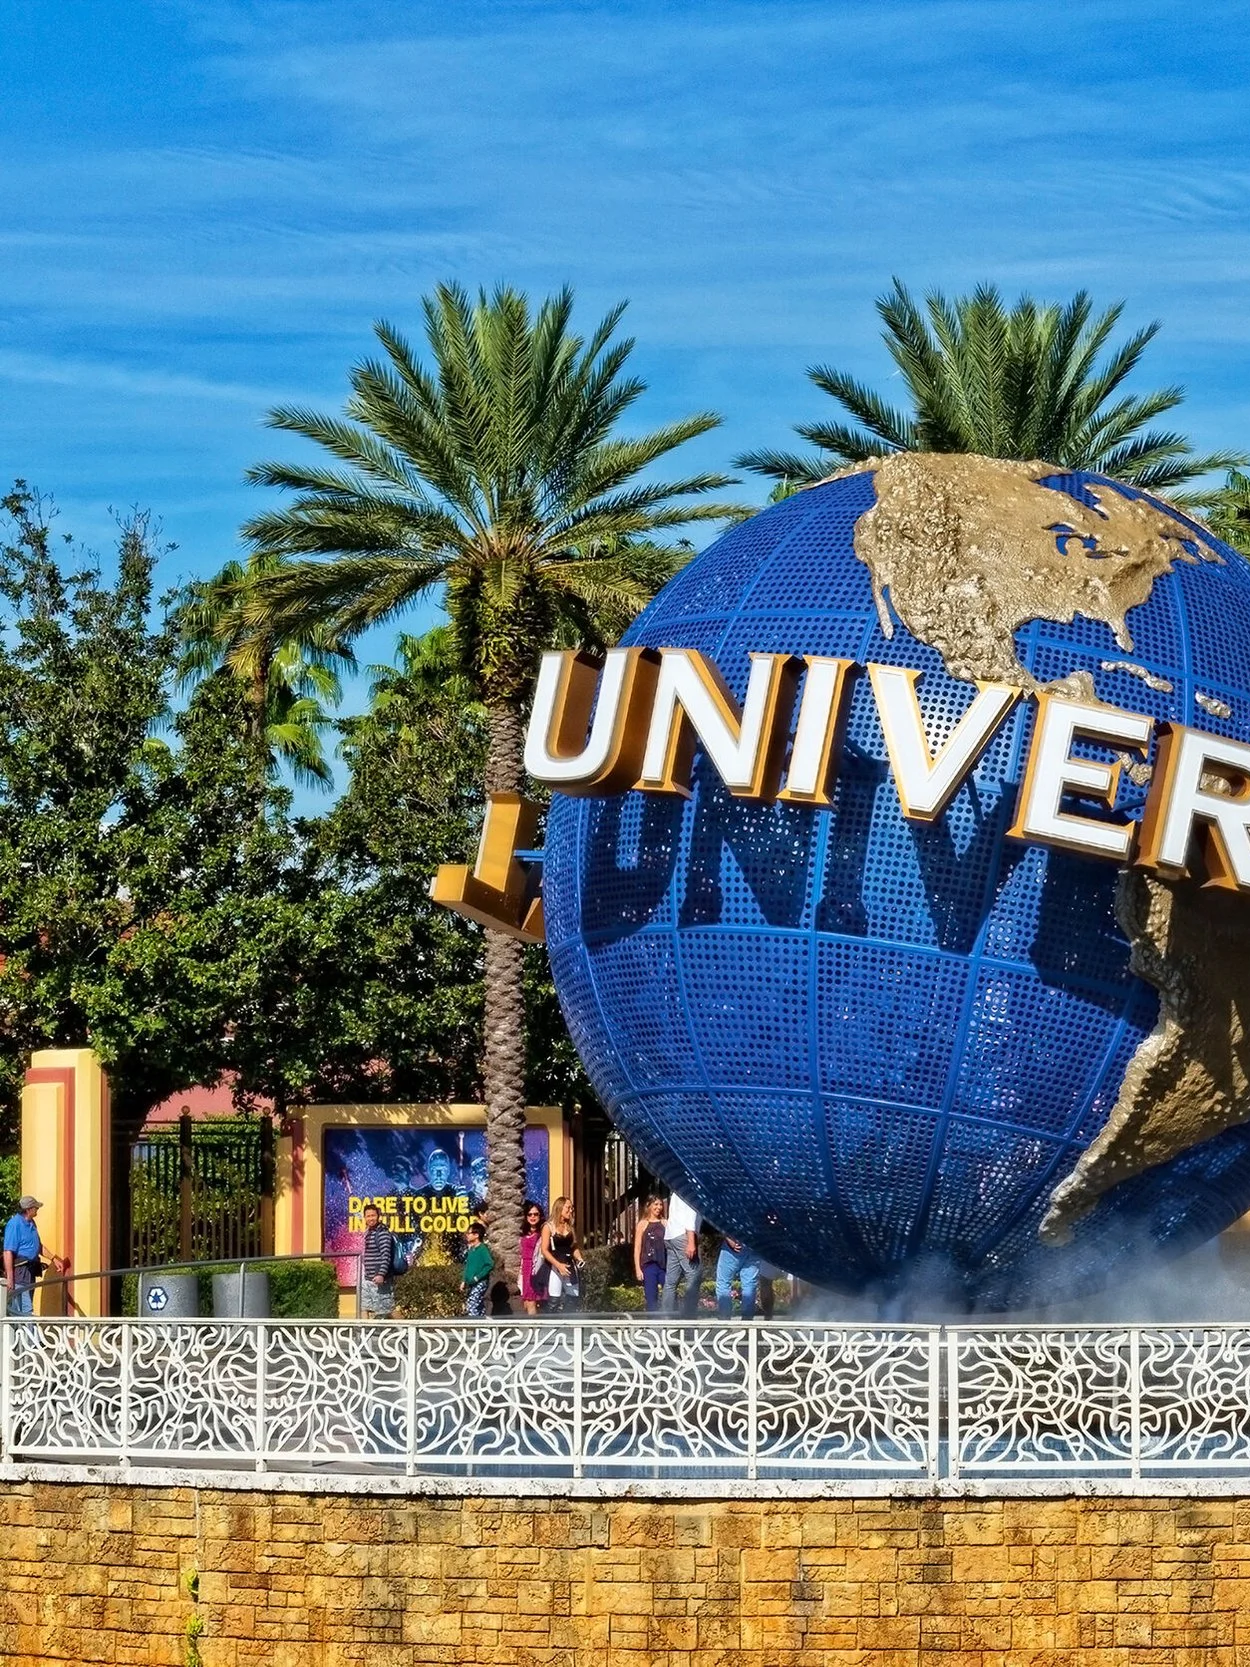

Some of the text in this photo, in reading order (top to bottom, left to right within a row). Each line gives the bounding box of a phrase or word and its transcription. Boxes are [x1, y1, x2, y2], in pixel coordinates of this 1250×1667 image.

[401, 1196, 427, 1214] TO
[431, 1196, 470, 1214] LIVE
[348, 1216, 367, 1233] IN
[378, 1216, 415, 1233] ULL
